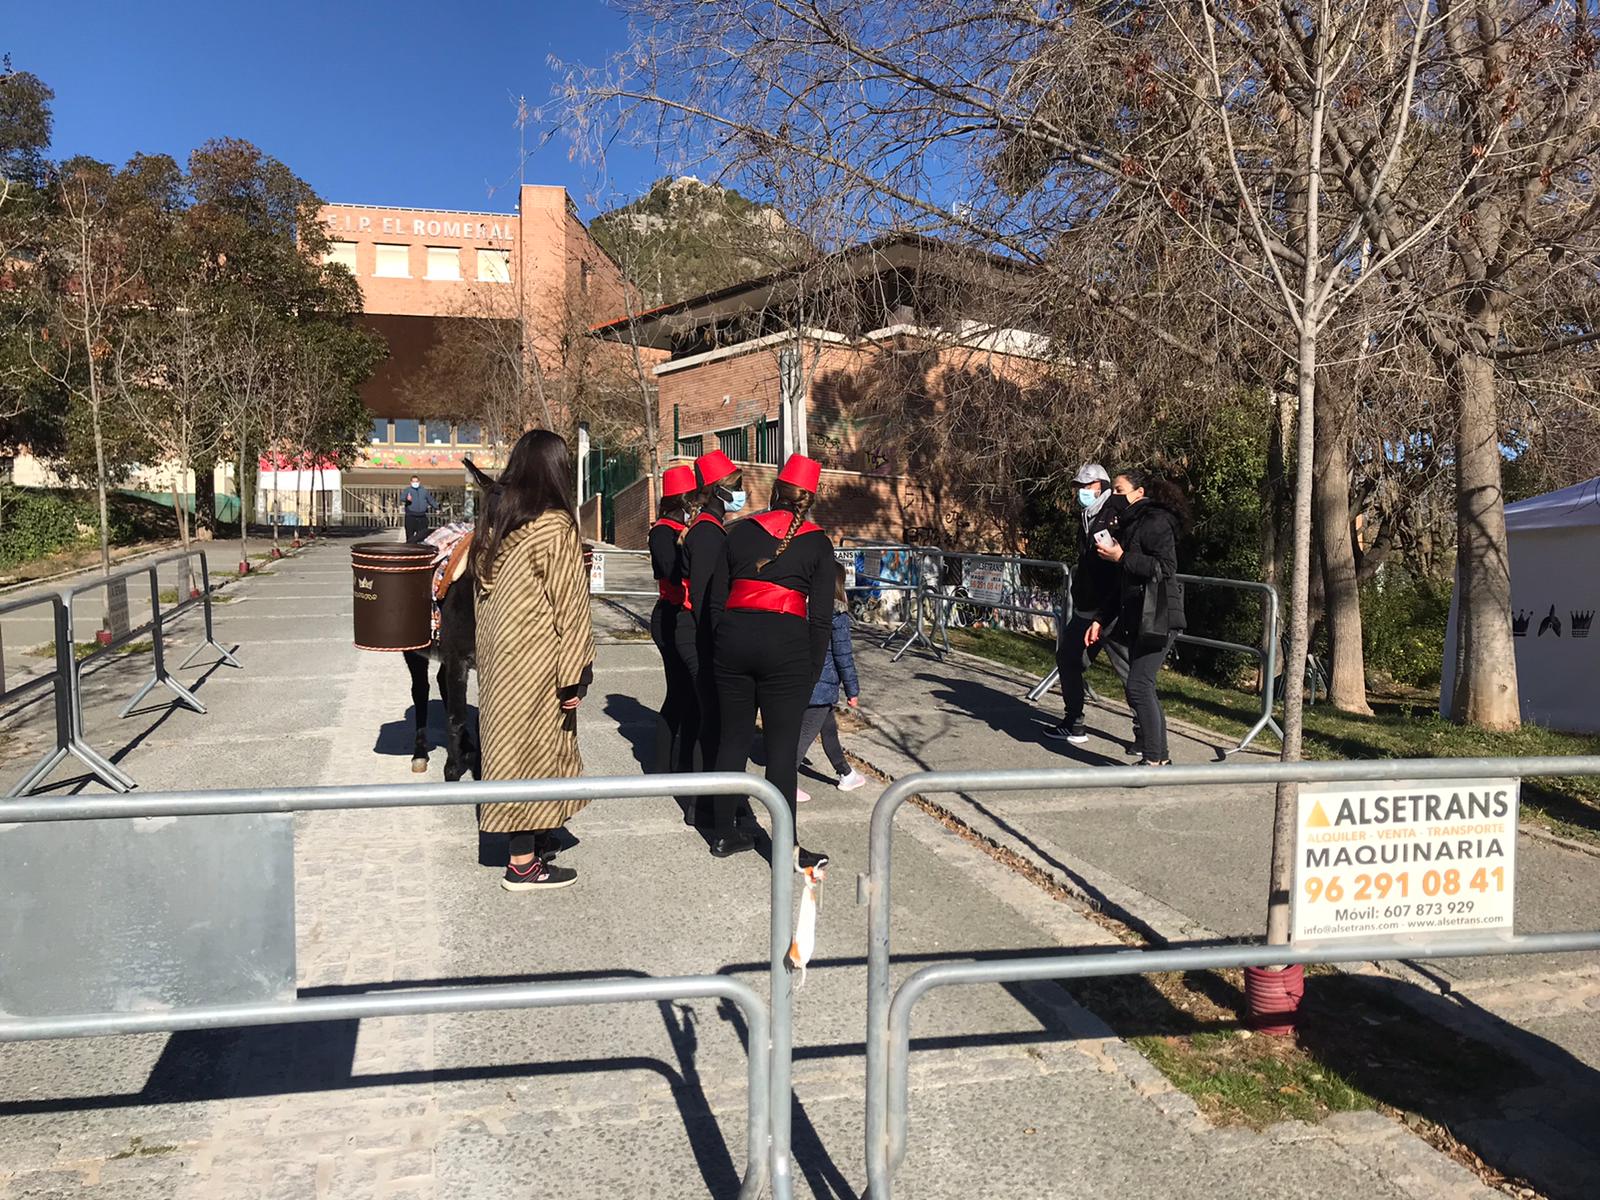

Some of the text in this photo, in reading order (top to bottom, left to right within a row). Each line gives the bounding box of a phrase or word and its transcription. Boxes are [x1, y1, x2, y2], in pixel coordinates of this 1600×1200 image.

[383, 217, 405, 234] EL
[413, 219, 514, 240] ROMERAL
[1334, 791, 1508, 826] ALSETRANS
[1307, 831, 1367, 843] ALQUILER
[1377, 828, 1416, 840] VENTA
[1426, 823, 1505, 837] TRANSPORTE
[1306, 838, 1504, 868] MAQUINARIA
[1305, 866, 1504, 904] 96 291 08 41
[1335, 900, 1475, 921] Móvil: 607 873 929
[1303, 921, 1399, 935] info@alsetrans.com
[1407, 915, 1504, 928] www.alsetrans.com
